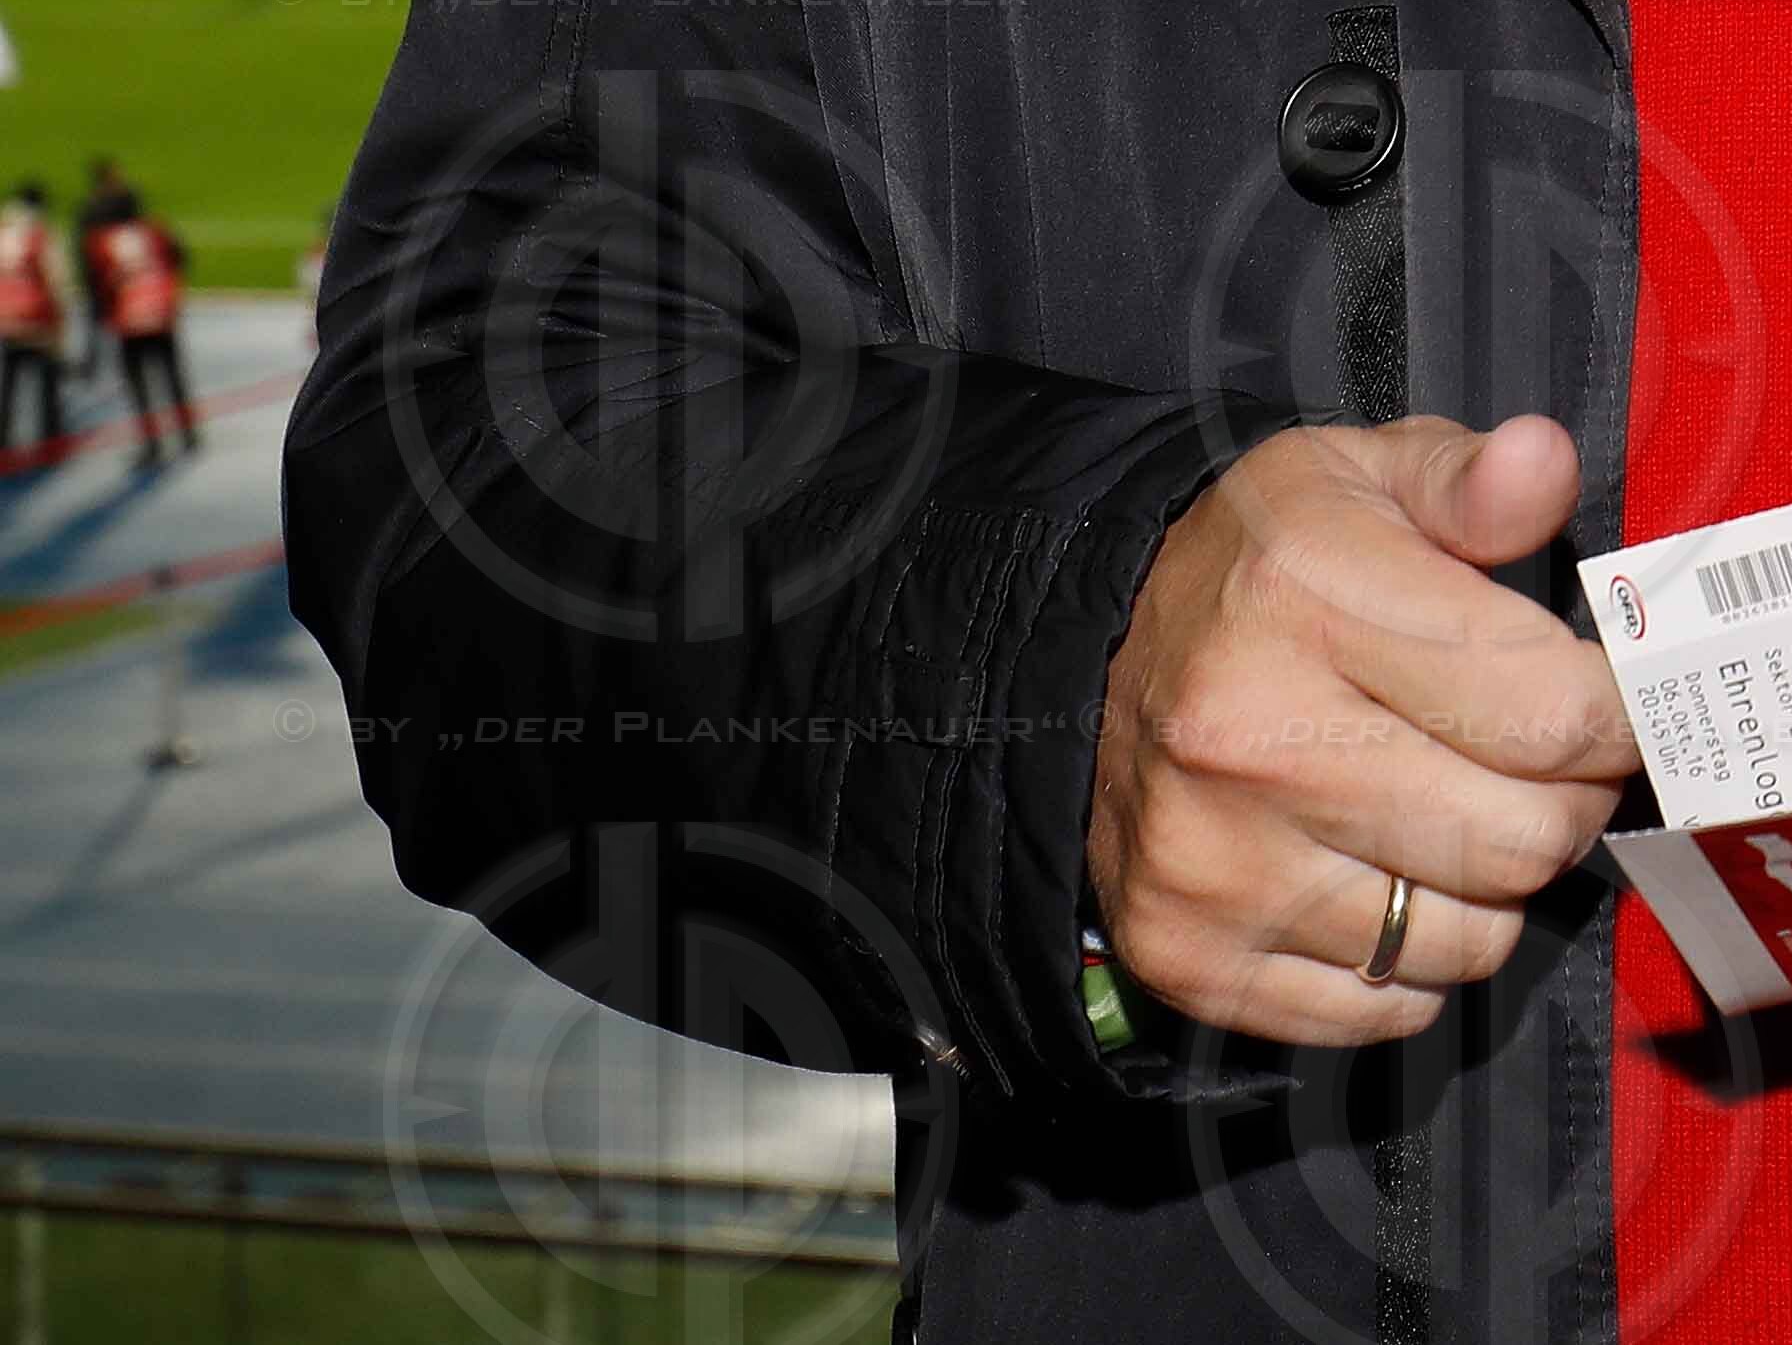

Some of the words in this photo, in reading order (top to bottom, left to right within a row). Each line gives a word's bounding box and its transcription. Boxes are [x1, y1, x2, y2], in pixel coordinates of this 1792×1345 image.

[1636, 683, 1671, 741] 20:45
[1656, 744, 1683, 780] Uhr
[1658, 676, 1707, 779] 06.Okt.16
[1683, 669, 1732, 783] Donnerstag
[1717, 658, 1791, 812] Ehrenlog
